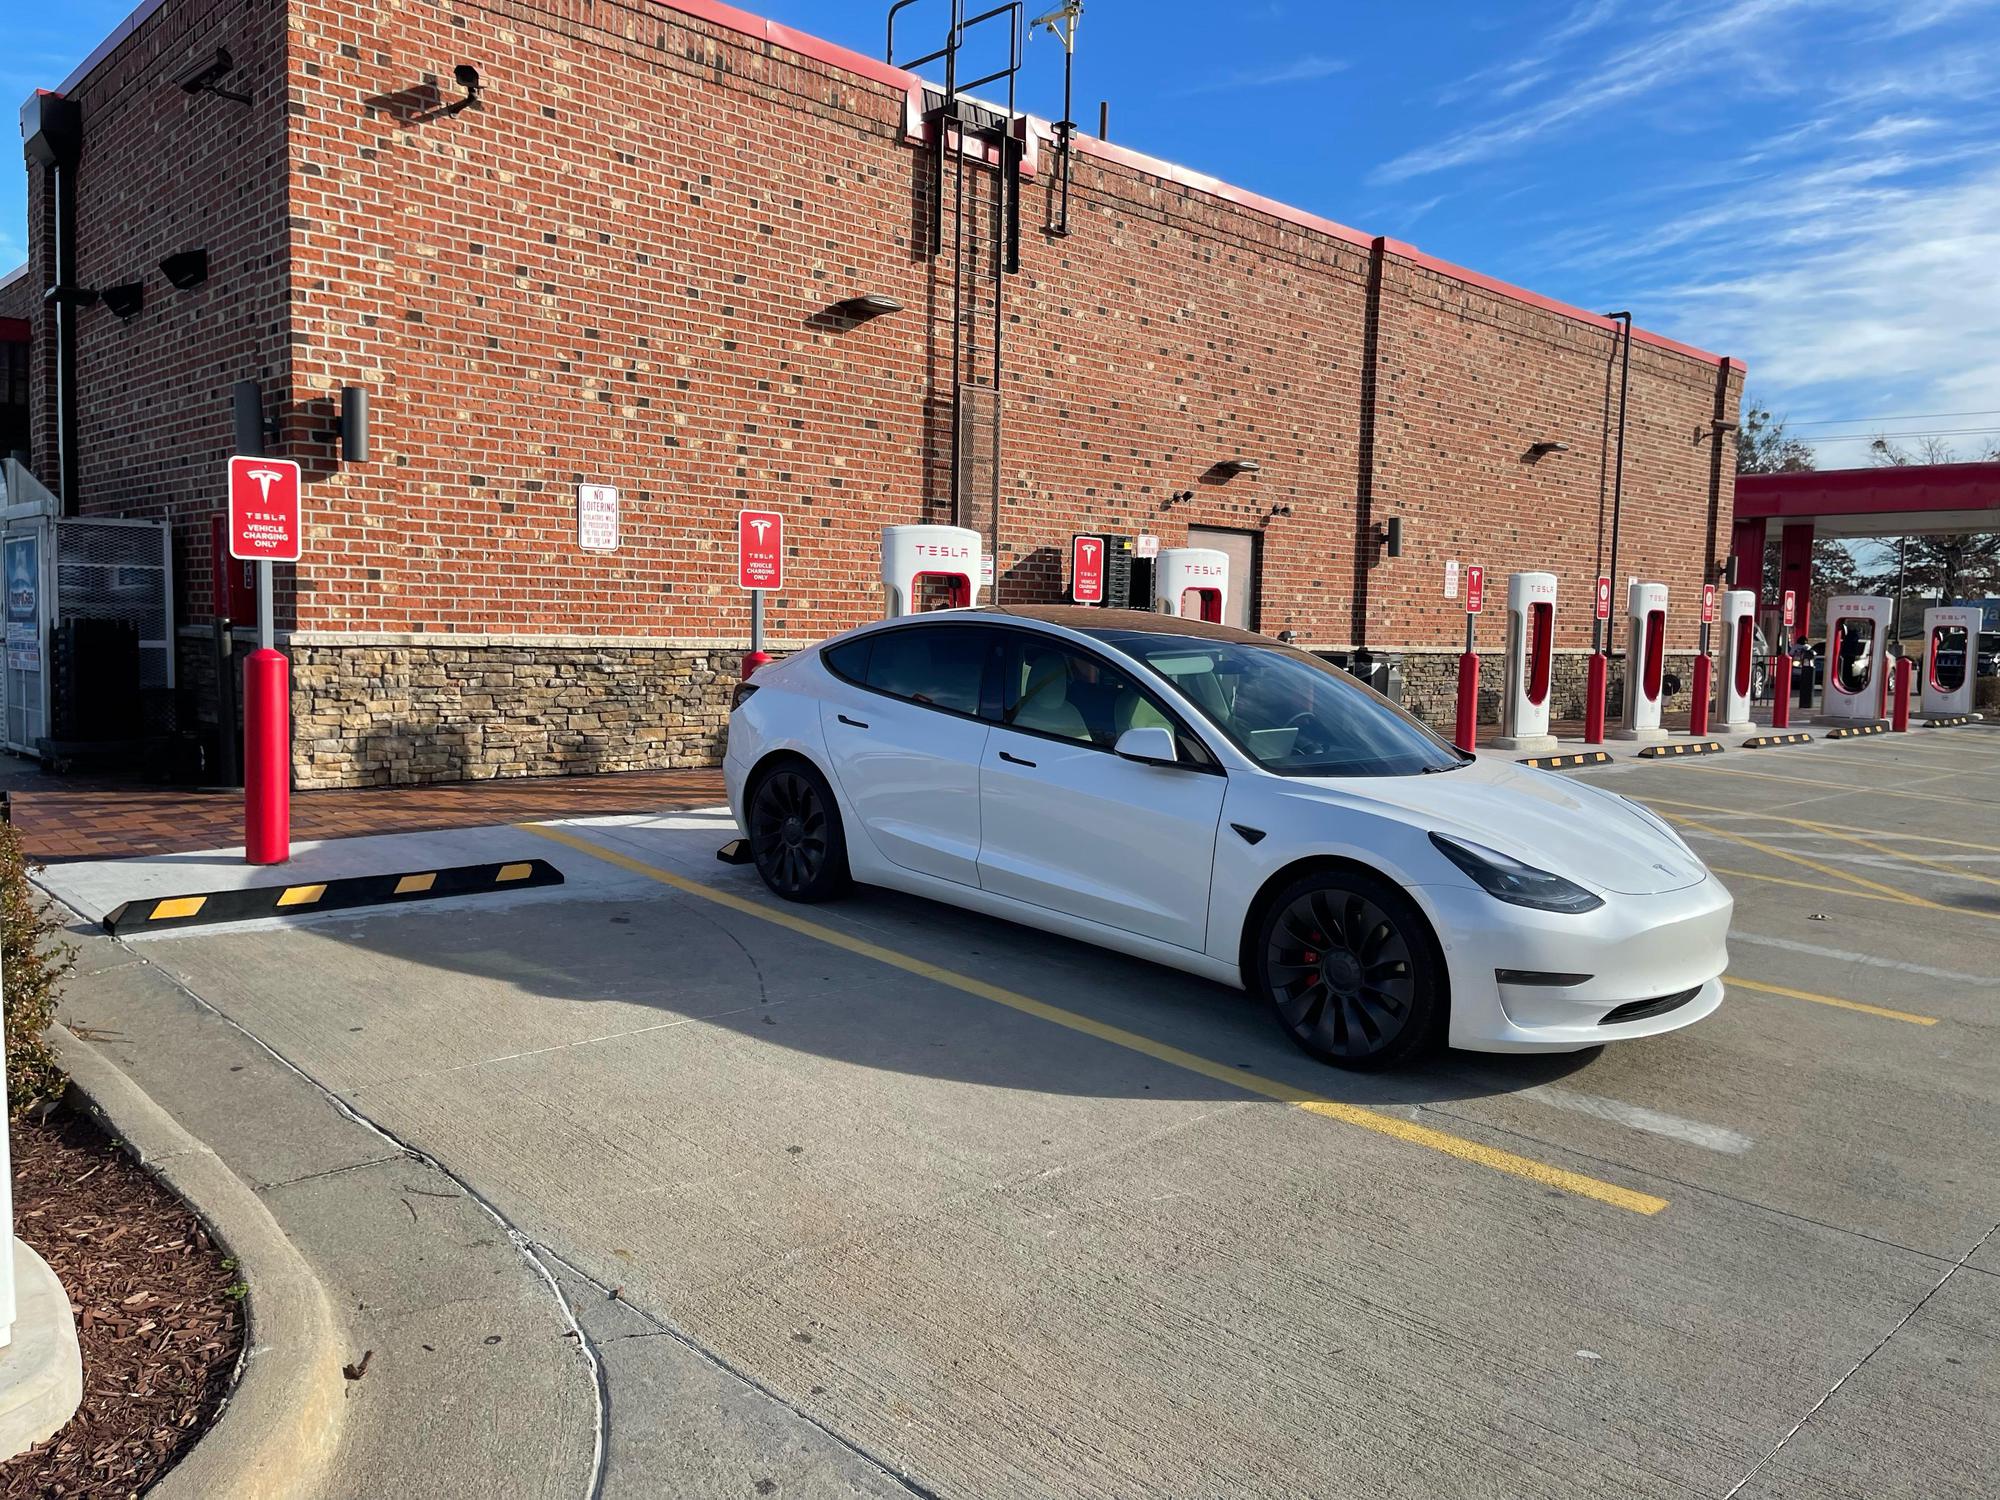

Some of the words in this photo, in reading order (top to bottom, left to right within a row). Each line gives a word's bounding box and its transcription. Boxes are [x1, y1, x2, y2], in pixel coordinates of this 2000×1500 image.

[594, 490, 604, 500] NO
[582, 501, 615, 513] LOITERING
[246, 512, 286, 522] TESLA
[247, 524, 284, 533] VEHICLE
[243, 531, 288, 541] CHARGING
[254, 540, 277, 548] ONLY
[915, 545, 968, 558] TESLA
[1185, 565, 1222, 575] TESLA
